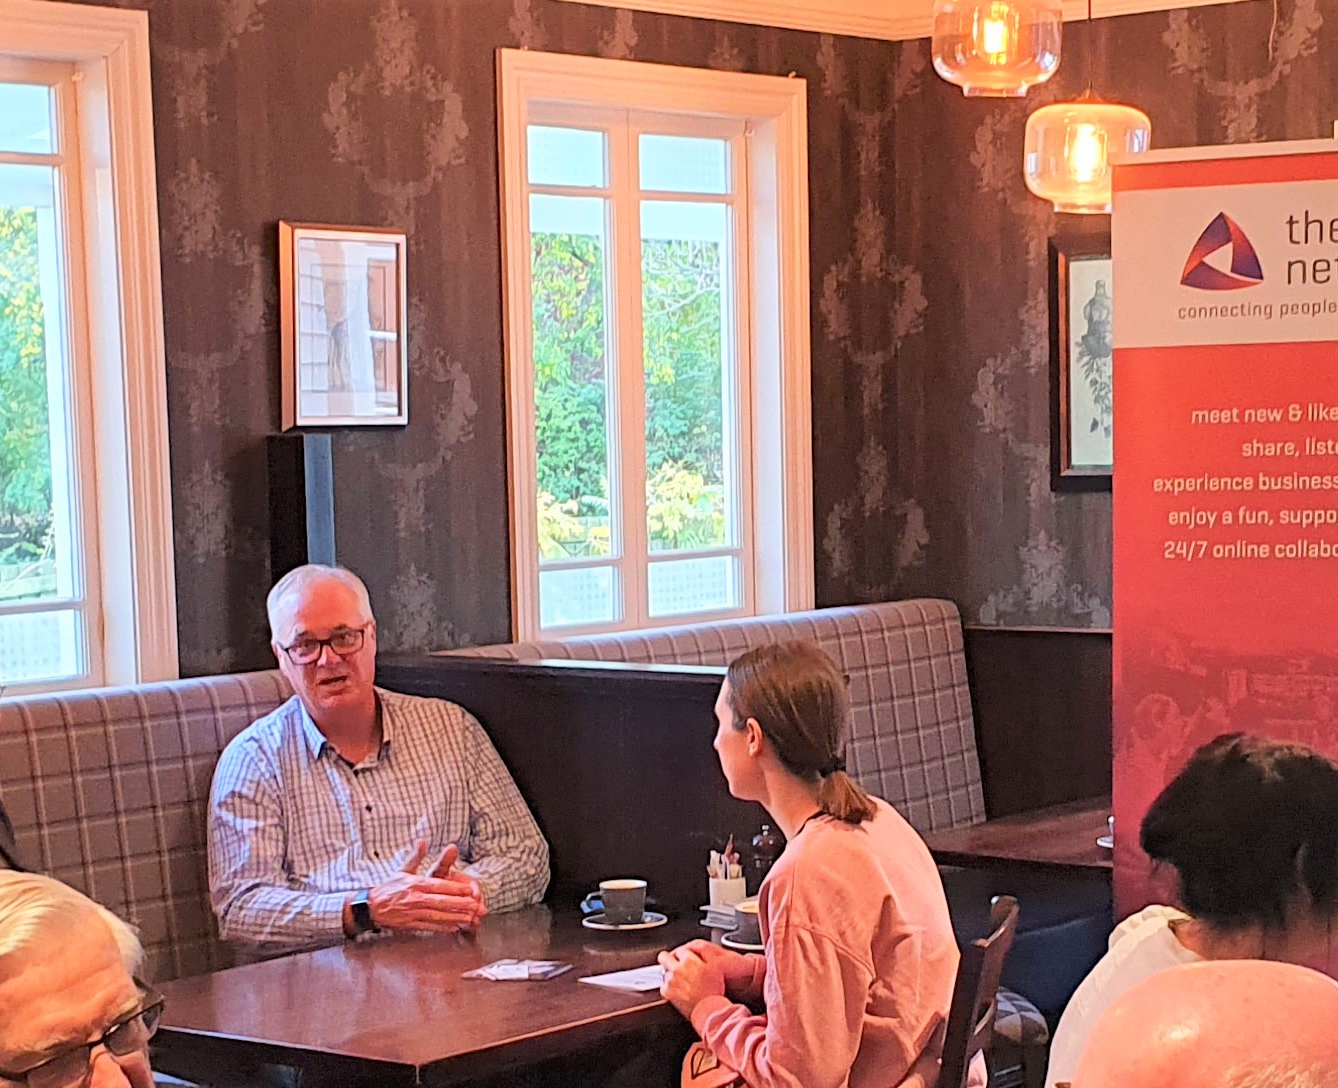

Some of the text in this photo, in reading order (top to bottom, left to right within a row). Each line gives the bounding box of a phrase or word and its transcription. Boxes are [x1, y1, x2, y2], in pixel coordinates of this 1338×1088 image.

[1178, 299, 1273, 320] connecting
[1280, 298, 1337, 319] people
[1191, 404, 1239, 425] meet
[1245, 406, 1282, 423] new
[1288, 403, 1302, 422] &
[1241, 438, 1300, 458] share,
[1153, 472, 1253, 494] experience
[1168, 507, 1217, 530] enjoy
[1222, 509, 1233, 525] a
[1238, 506, 1274, 526] fun,
[1164, 539, 1207, 560] 24/7
[1212, 540, 1270, 558] online
